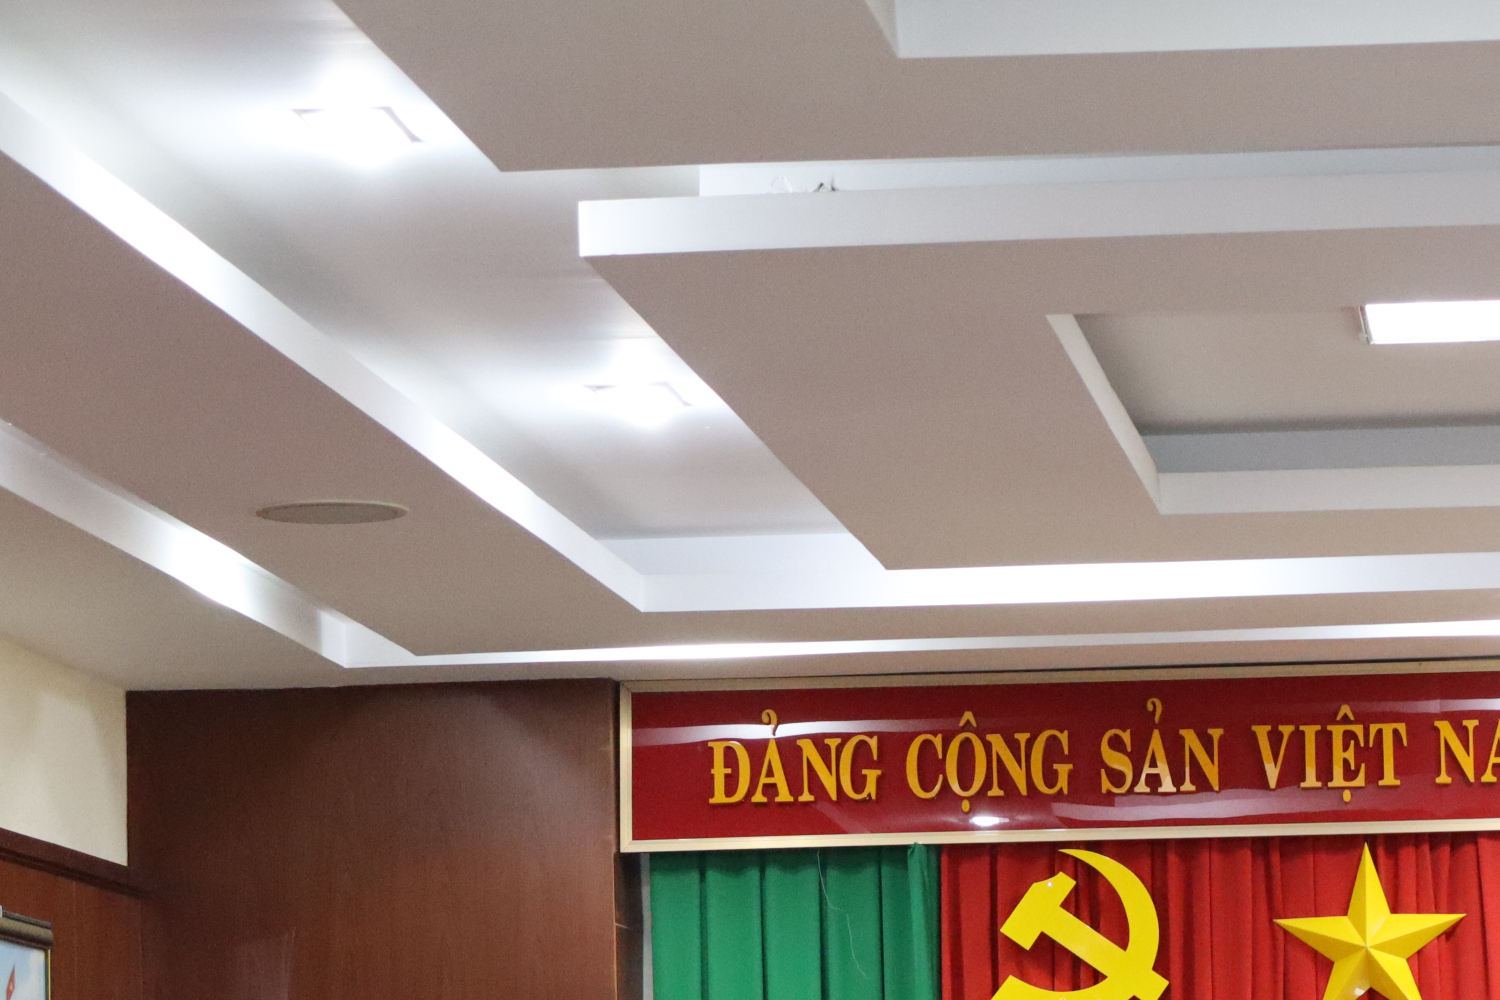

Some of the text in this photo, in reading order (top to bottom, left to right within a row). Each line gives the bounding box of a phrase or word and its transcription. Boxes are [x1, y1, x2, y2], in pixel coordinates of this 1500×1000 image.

[708, 708, 880, 805] ĐẢNG
[906, 711, 1074, 813] CỘNG
[1100, 697, 1225, 796] SẢN
[1251, 704, 1407, 803] VIỆT
